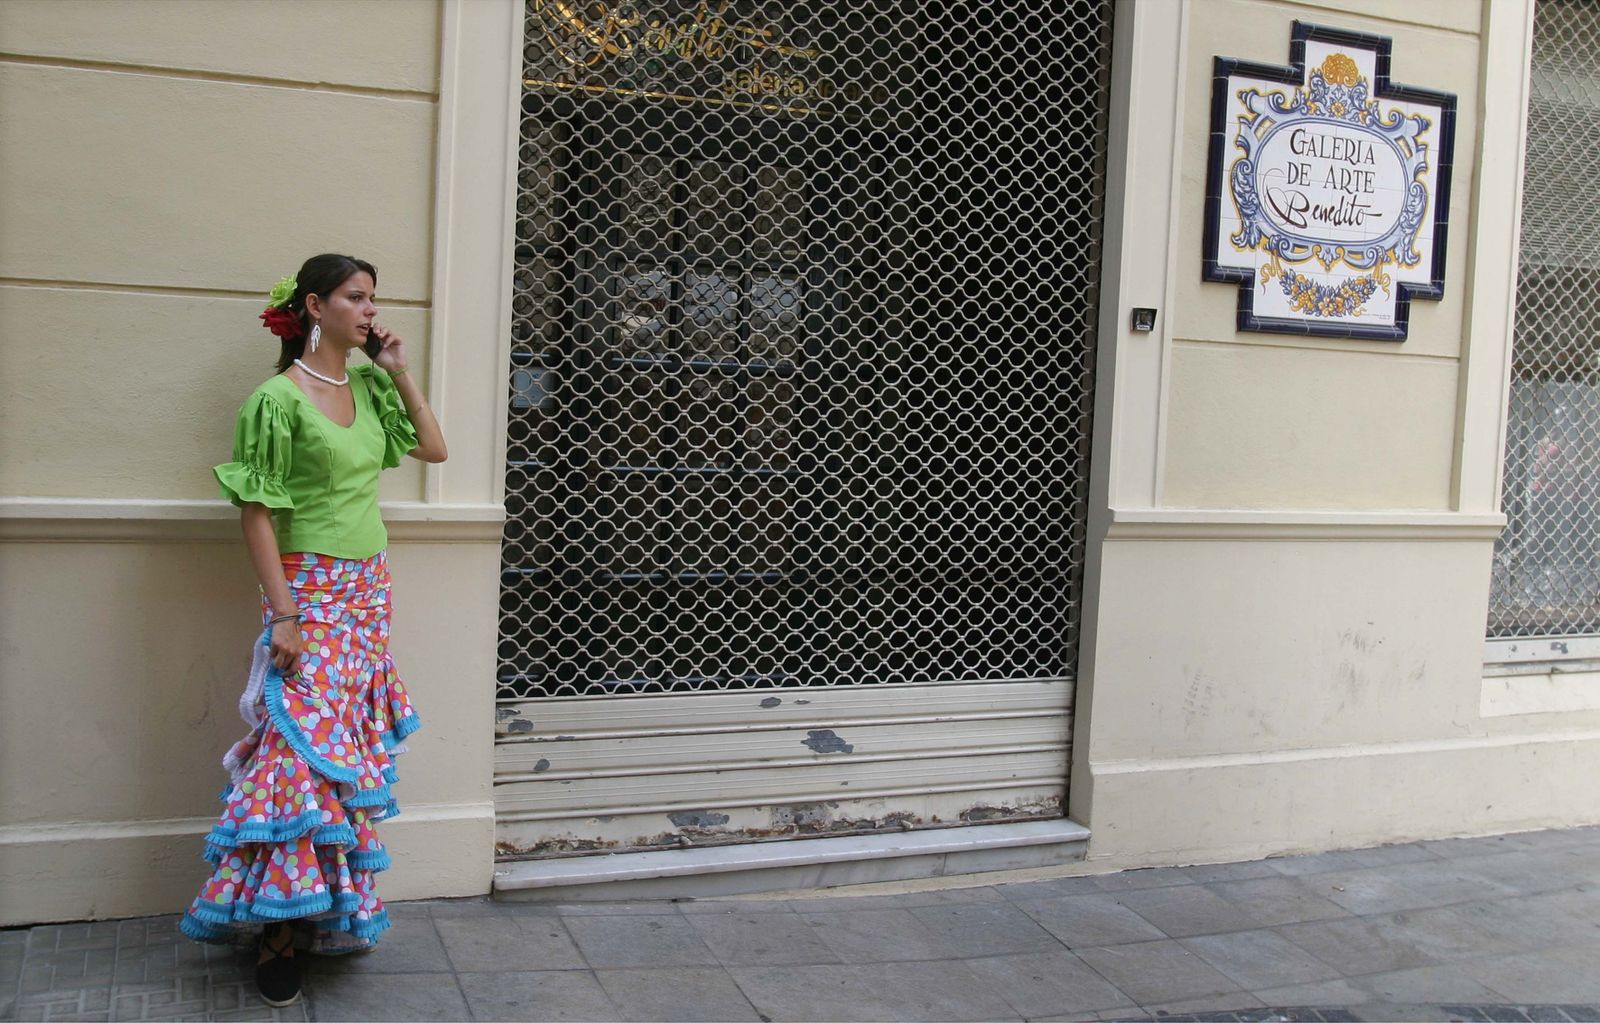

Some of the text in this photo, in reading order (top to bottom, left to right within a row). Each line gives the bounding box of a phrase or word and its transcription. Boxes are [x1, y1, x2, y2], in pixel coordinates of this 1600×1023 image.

[1289, 127, 1376, 166] GALERIA
[1287, 160, 1376, 195] DE ARTE
[1263, 182, 1383, 229] Benedito
